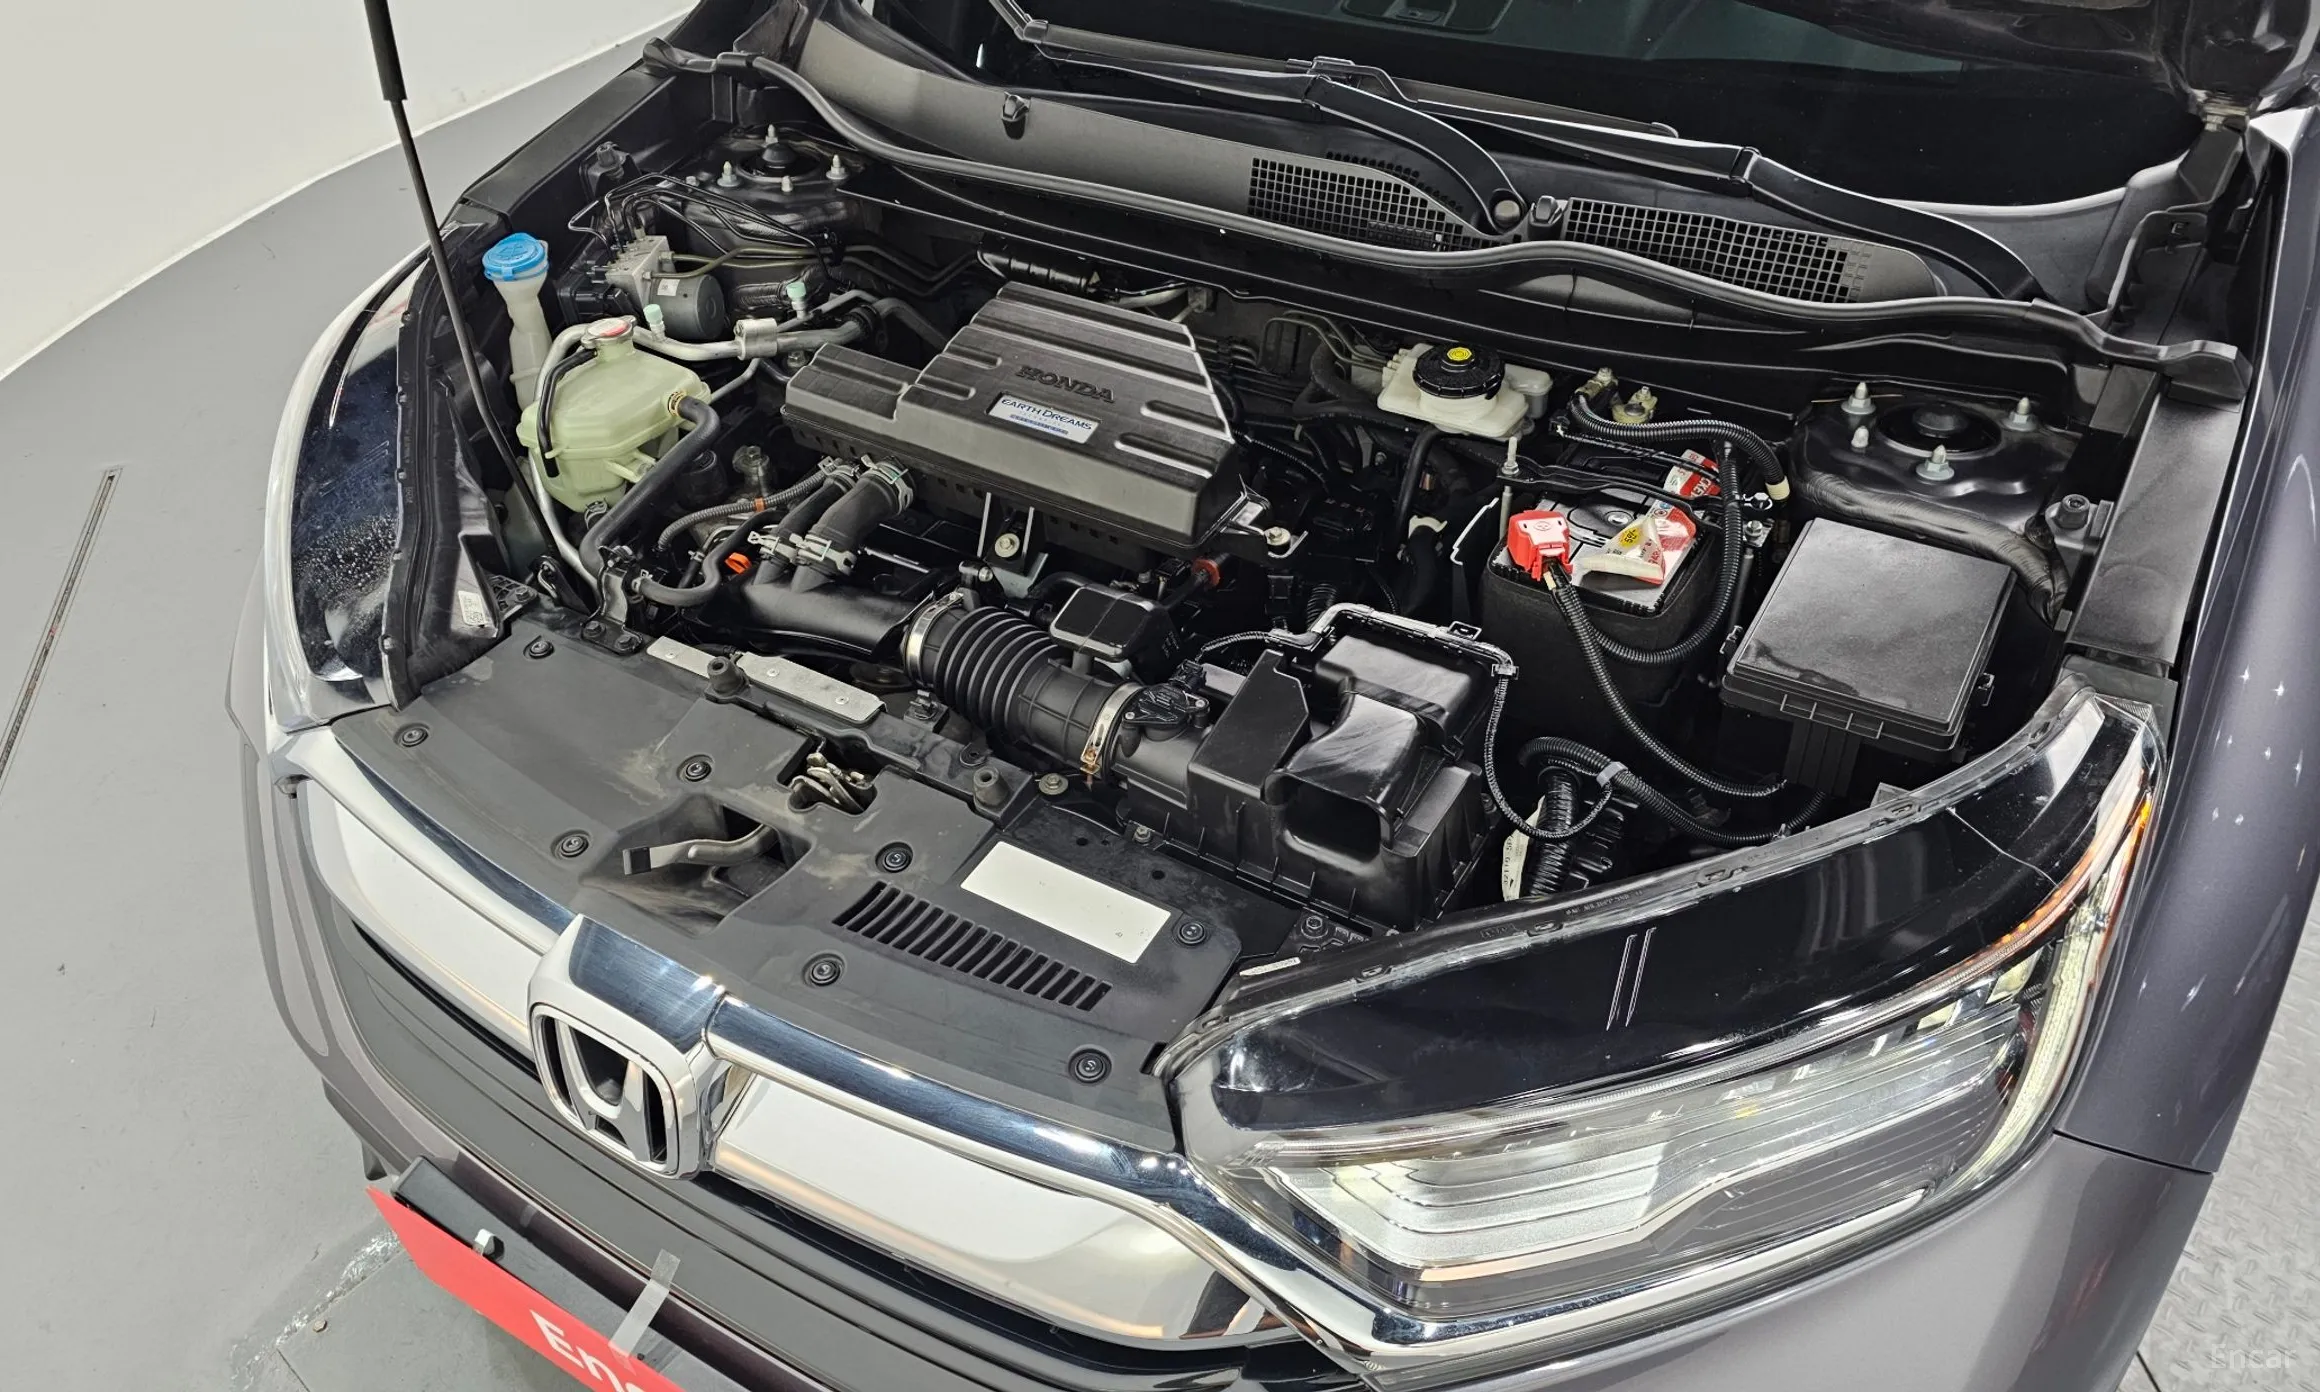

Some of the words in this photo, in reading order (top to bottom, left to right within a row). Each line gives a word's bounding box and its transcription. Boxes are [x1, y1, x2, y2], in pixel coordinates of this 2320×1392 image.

[1015, 365, 1115, 403] HONDA
[1001, 399, 1042, 415] EARTH
[1042, 409, 1092, 430] DREAMS
